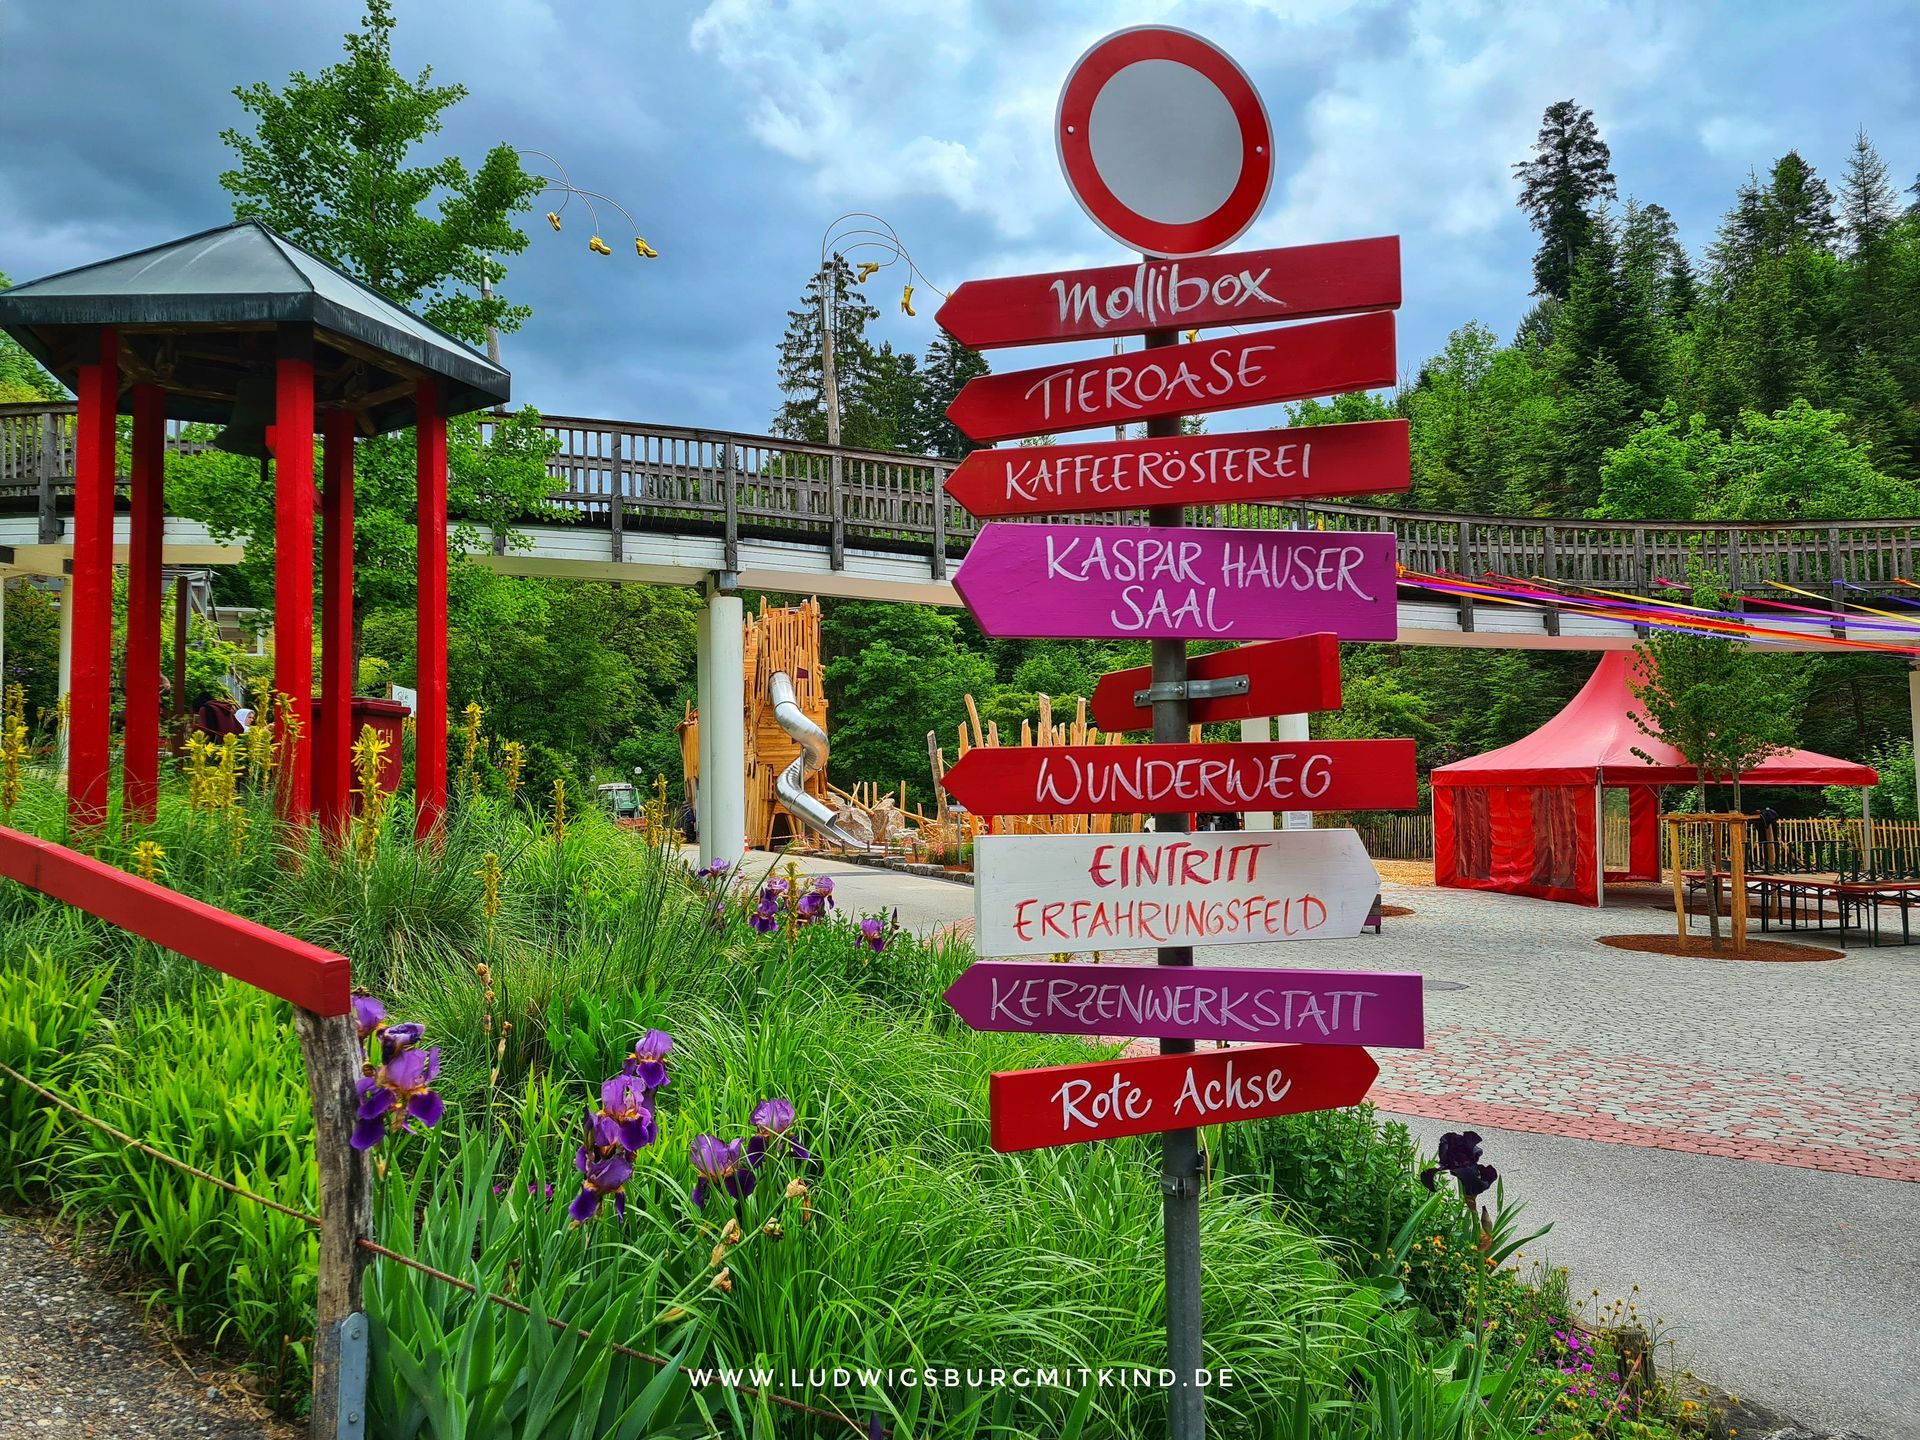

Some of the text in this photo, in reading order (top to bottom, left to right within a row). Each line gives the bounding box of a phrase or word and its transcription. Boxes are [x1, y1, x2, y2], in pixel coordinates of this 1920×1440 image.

[1024, 344, 1277, 421] TIEROASE
[1005, 443, 1312, 502] KAFFEERÖSTEREI
[1045, 534, 1377, 603] KASPAR HAUSER
[1110, 585, 1236, 633] SAAL
[1035, 753, 1334, 806] WUNDERWEG
[1088, 840, 1272, 890] EINTRITT
[1012, 892, 1328, 943] ERFAHRUNGSFELD
[989, 976, 1380, 1037] KERZENWERKSTATT
[1050, 1059, 1293, 1132] Rote Achse
